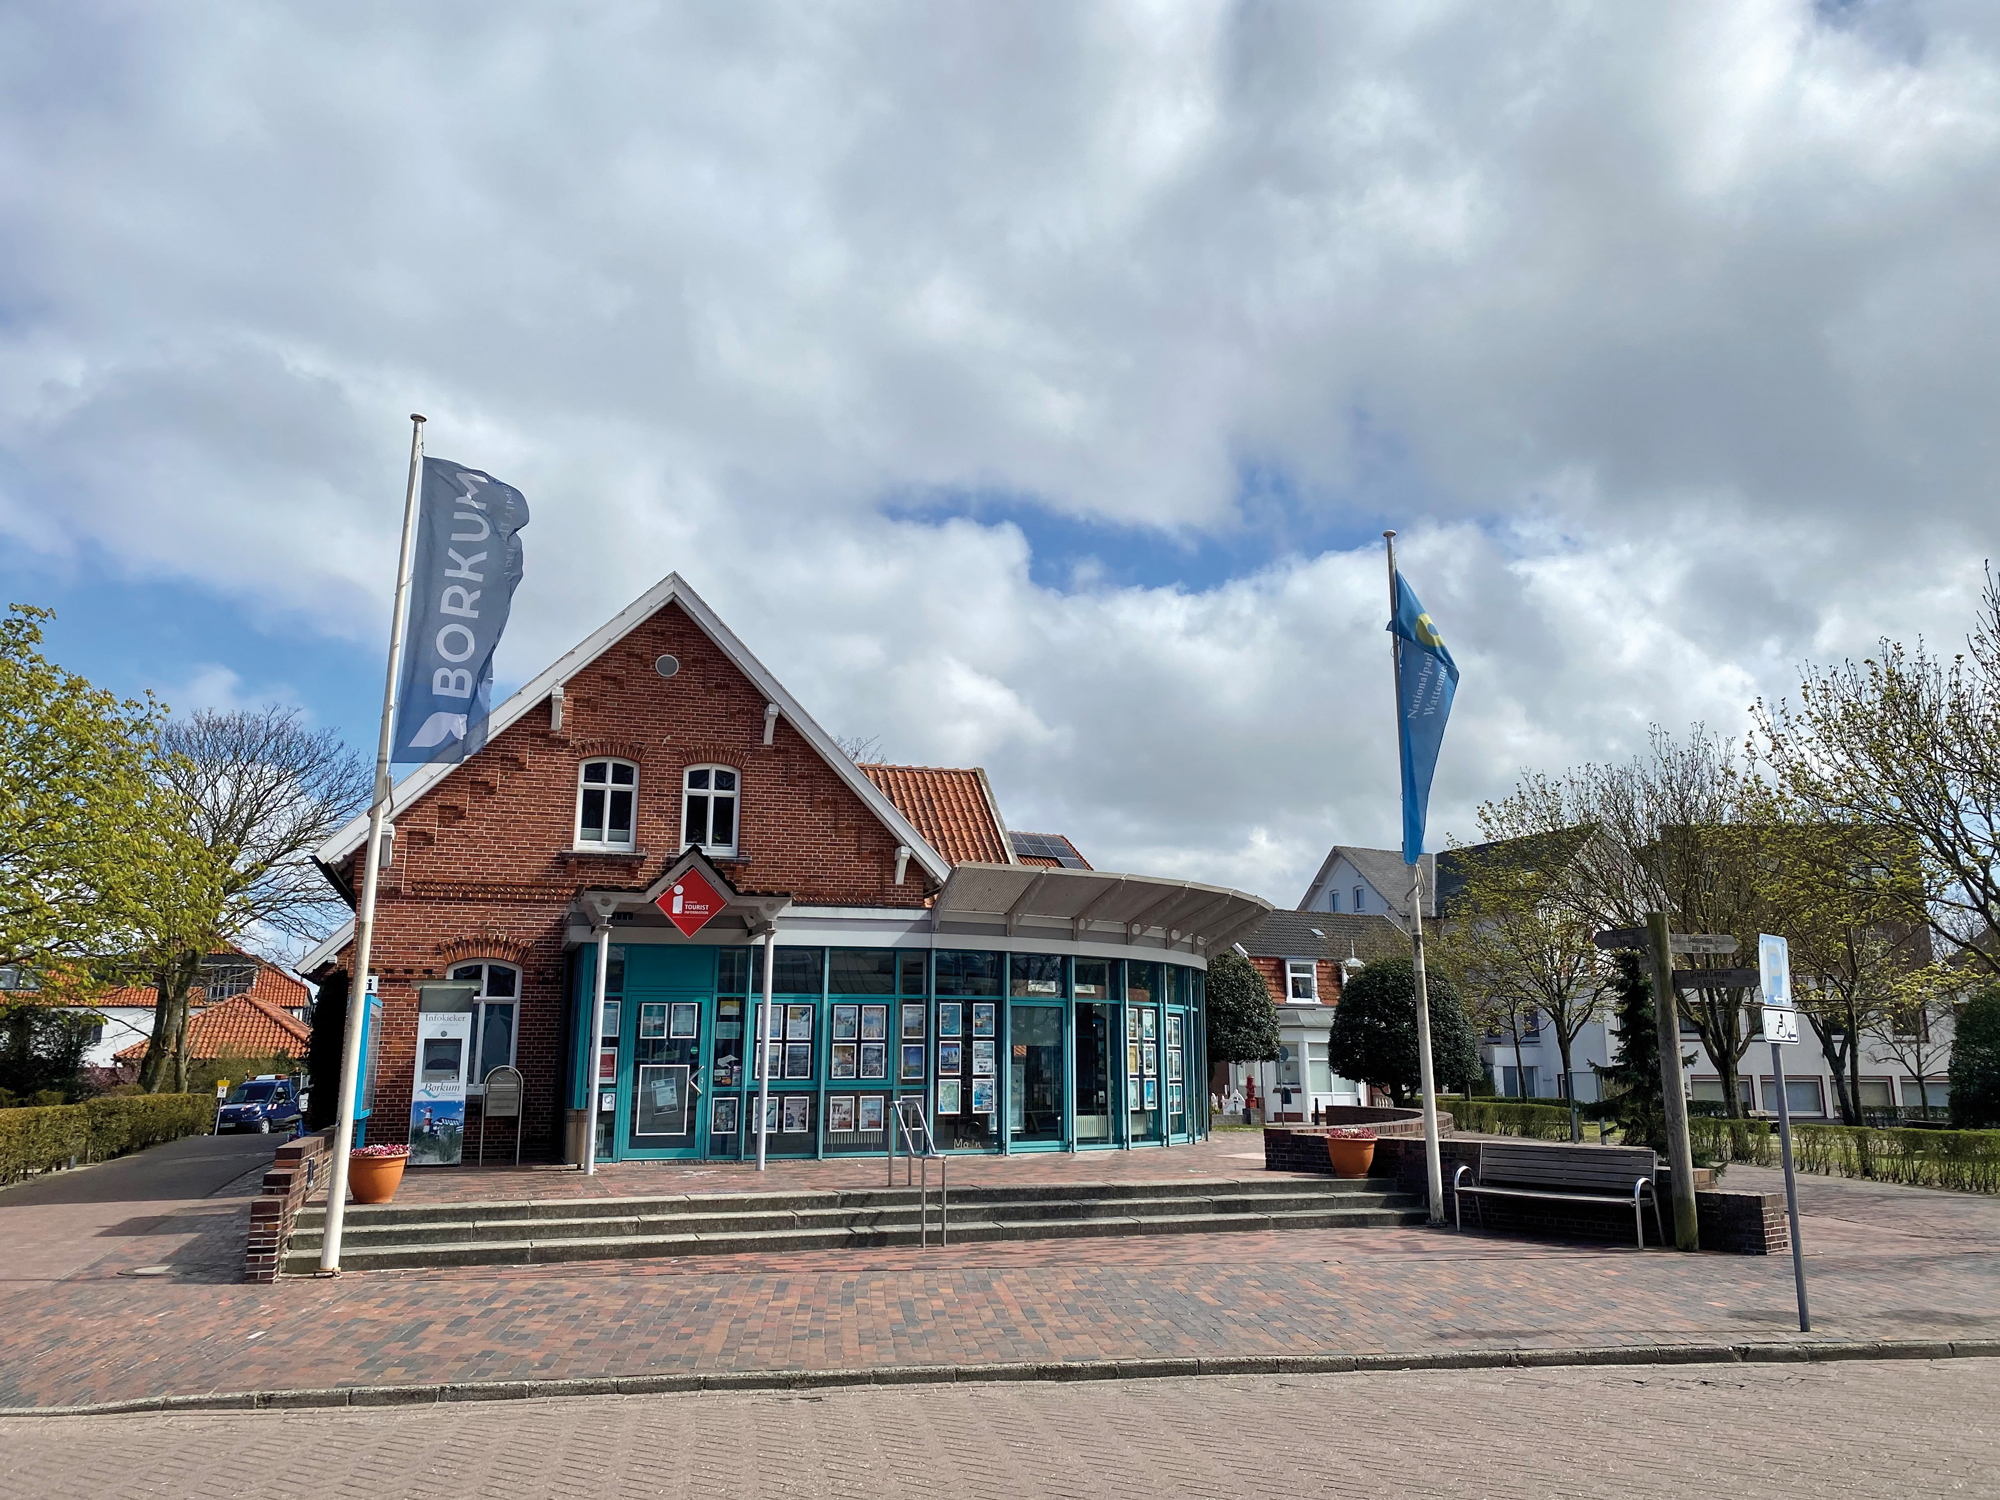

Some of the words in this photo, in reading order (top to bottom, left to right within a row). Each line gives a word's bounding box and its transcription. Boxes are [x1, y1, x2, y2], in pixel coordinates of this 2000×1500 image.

[432, 472, 491, 699] BORKUM
[1423, 664, 1449, 716] Wattenme
[1690, 970, 1708, 978] Grand
[1709, 969, 1733, 979] Canyon
[1766, 944, 1783, 995] P
[1716, 979, 1726, 987] km
[425, 1014, 466, 1022] Infokieker
[424, 1083, 460, 1092] Borkum
